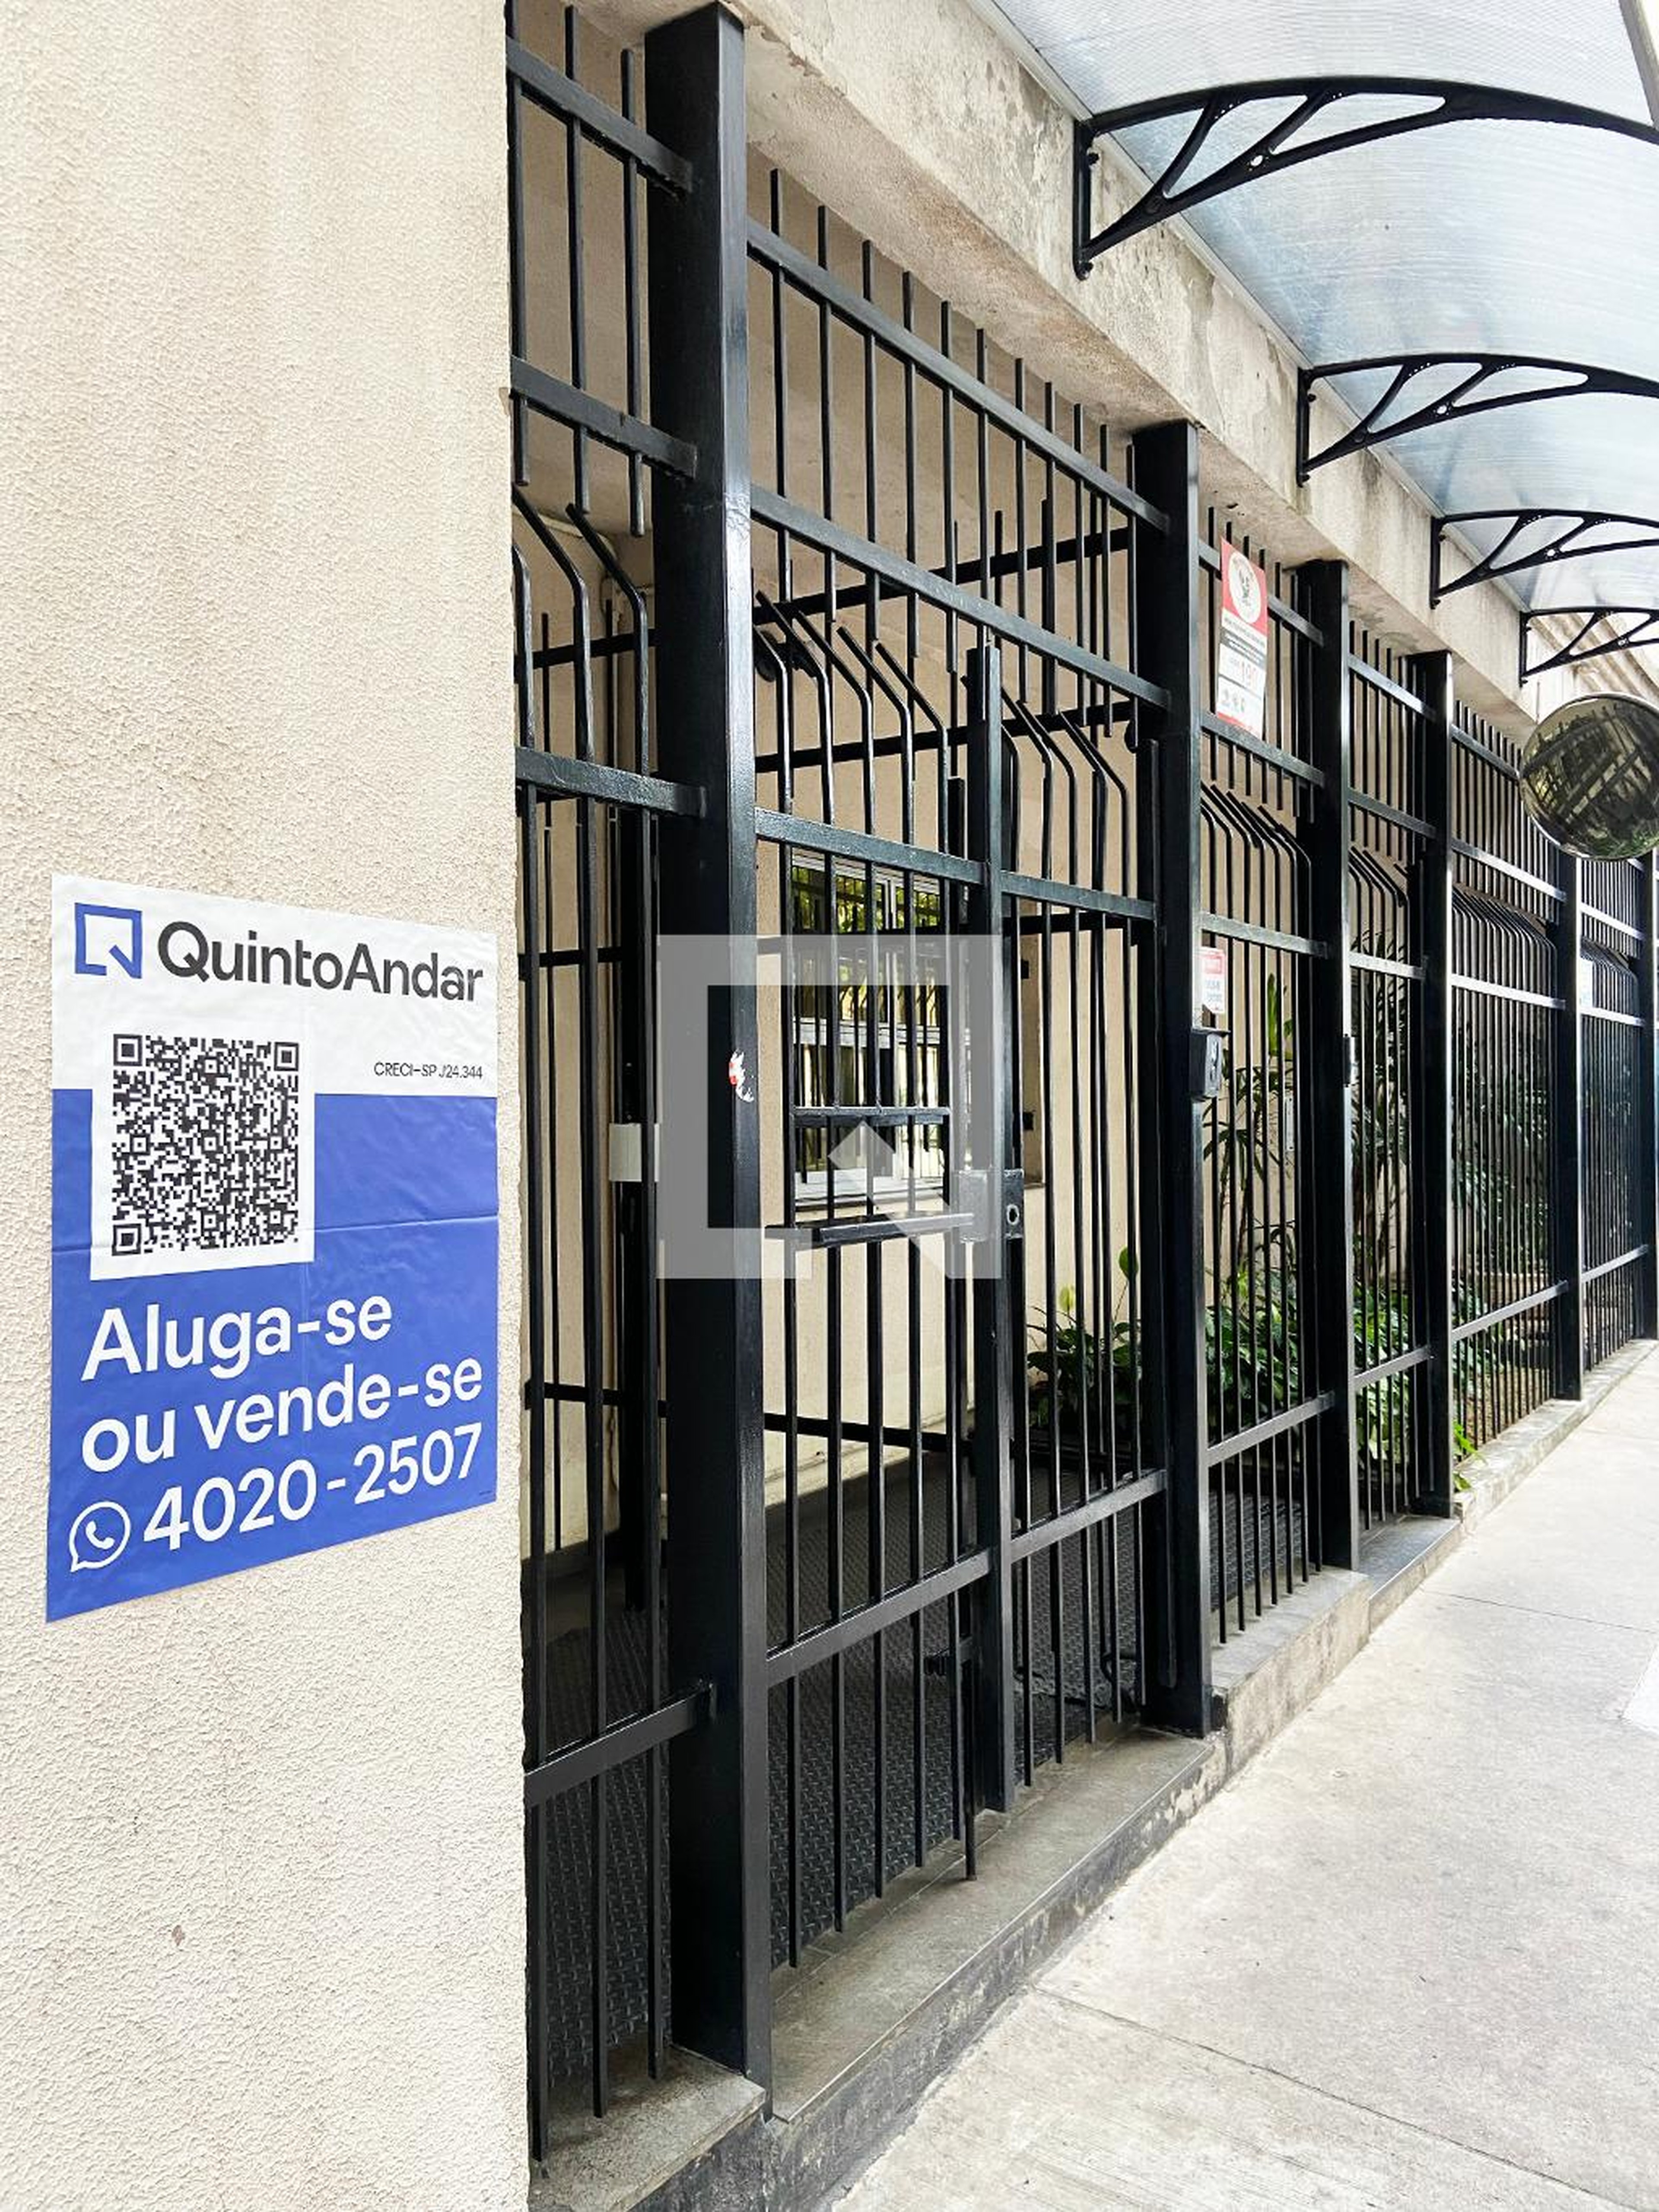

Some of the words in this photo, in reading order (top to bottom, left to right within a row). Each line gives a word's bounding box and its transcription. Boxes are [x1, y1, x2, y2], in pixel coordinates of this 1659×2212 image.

[157, 921, 483, 1002] QuintoAndar
[374, 1062, 437, 1076] CRECI-SP
[81, 1295, 392, 1381] Aluga-se
[82, 1409, 175, 1472] ou
[194, 1357, 483, 1449] vende-se
[143, 1422, 482, 1550] 4020-2507
